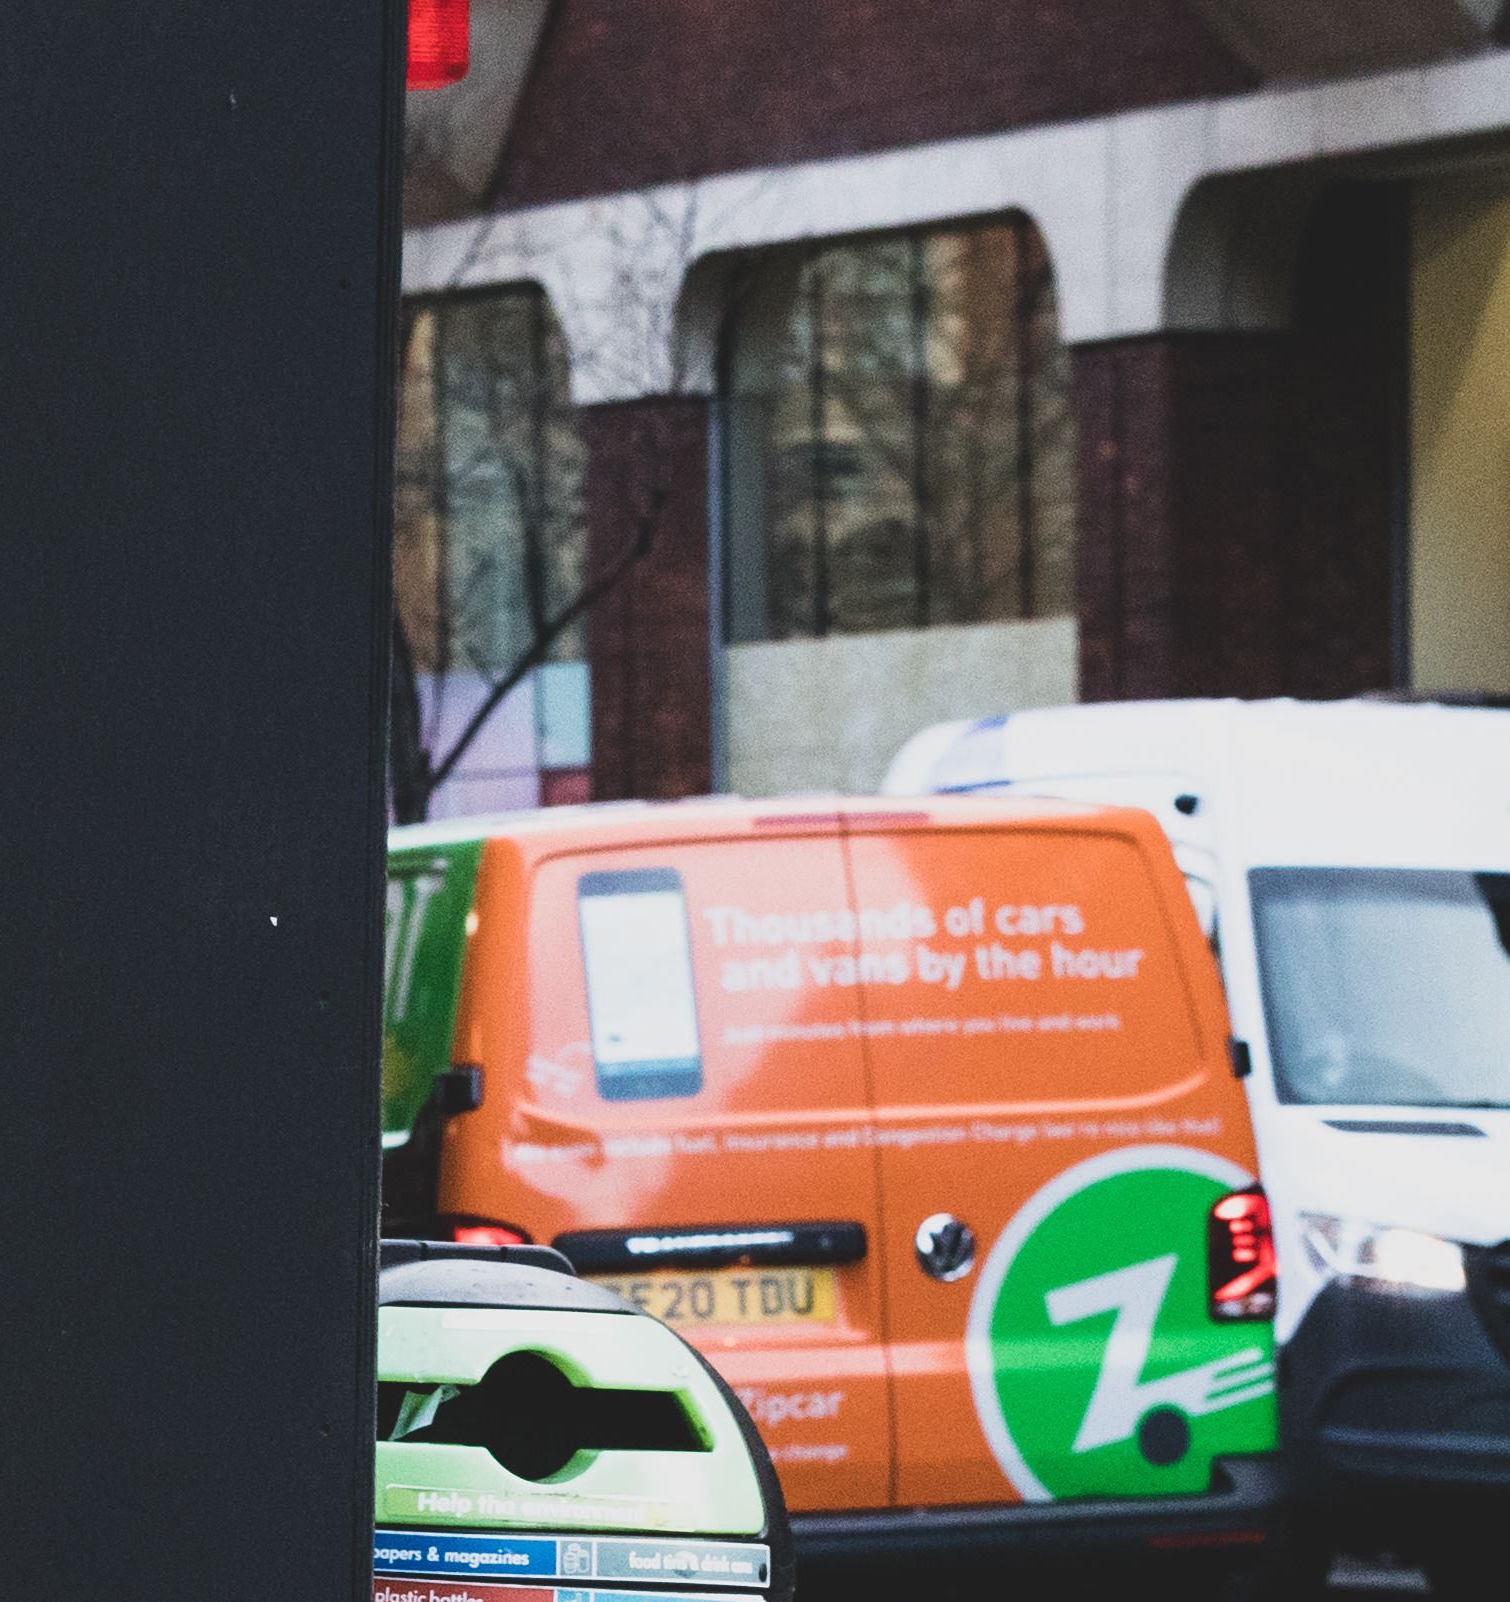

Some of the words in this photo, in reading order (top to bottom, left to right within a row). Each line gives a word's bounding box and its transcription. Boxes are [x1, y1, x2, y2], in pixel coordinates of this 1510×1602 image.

[703, 902, 937, 945] Thousands
[945, 897, 984, 937] of
[995, 903, 1085, 937] cars
[721, 951, 800, 992] and
[808, 953, 908, 988] vans
[916, 943, 965, 991] by
[975, 942, 1041, 981] the
[1050, 940, 1145, 980] hour
[731, 1271, 815, 1316] TDU
[418, 1491, 473, 1517] Help
[476, 1494, 517, 1516] the
[521, 1498, 647, 1525] environment
[427, 1546, 440, 1562] &
[444, 1548, 530, 1569] magazines
[628, 1550, 661, 1570] food
